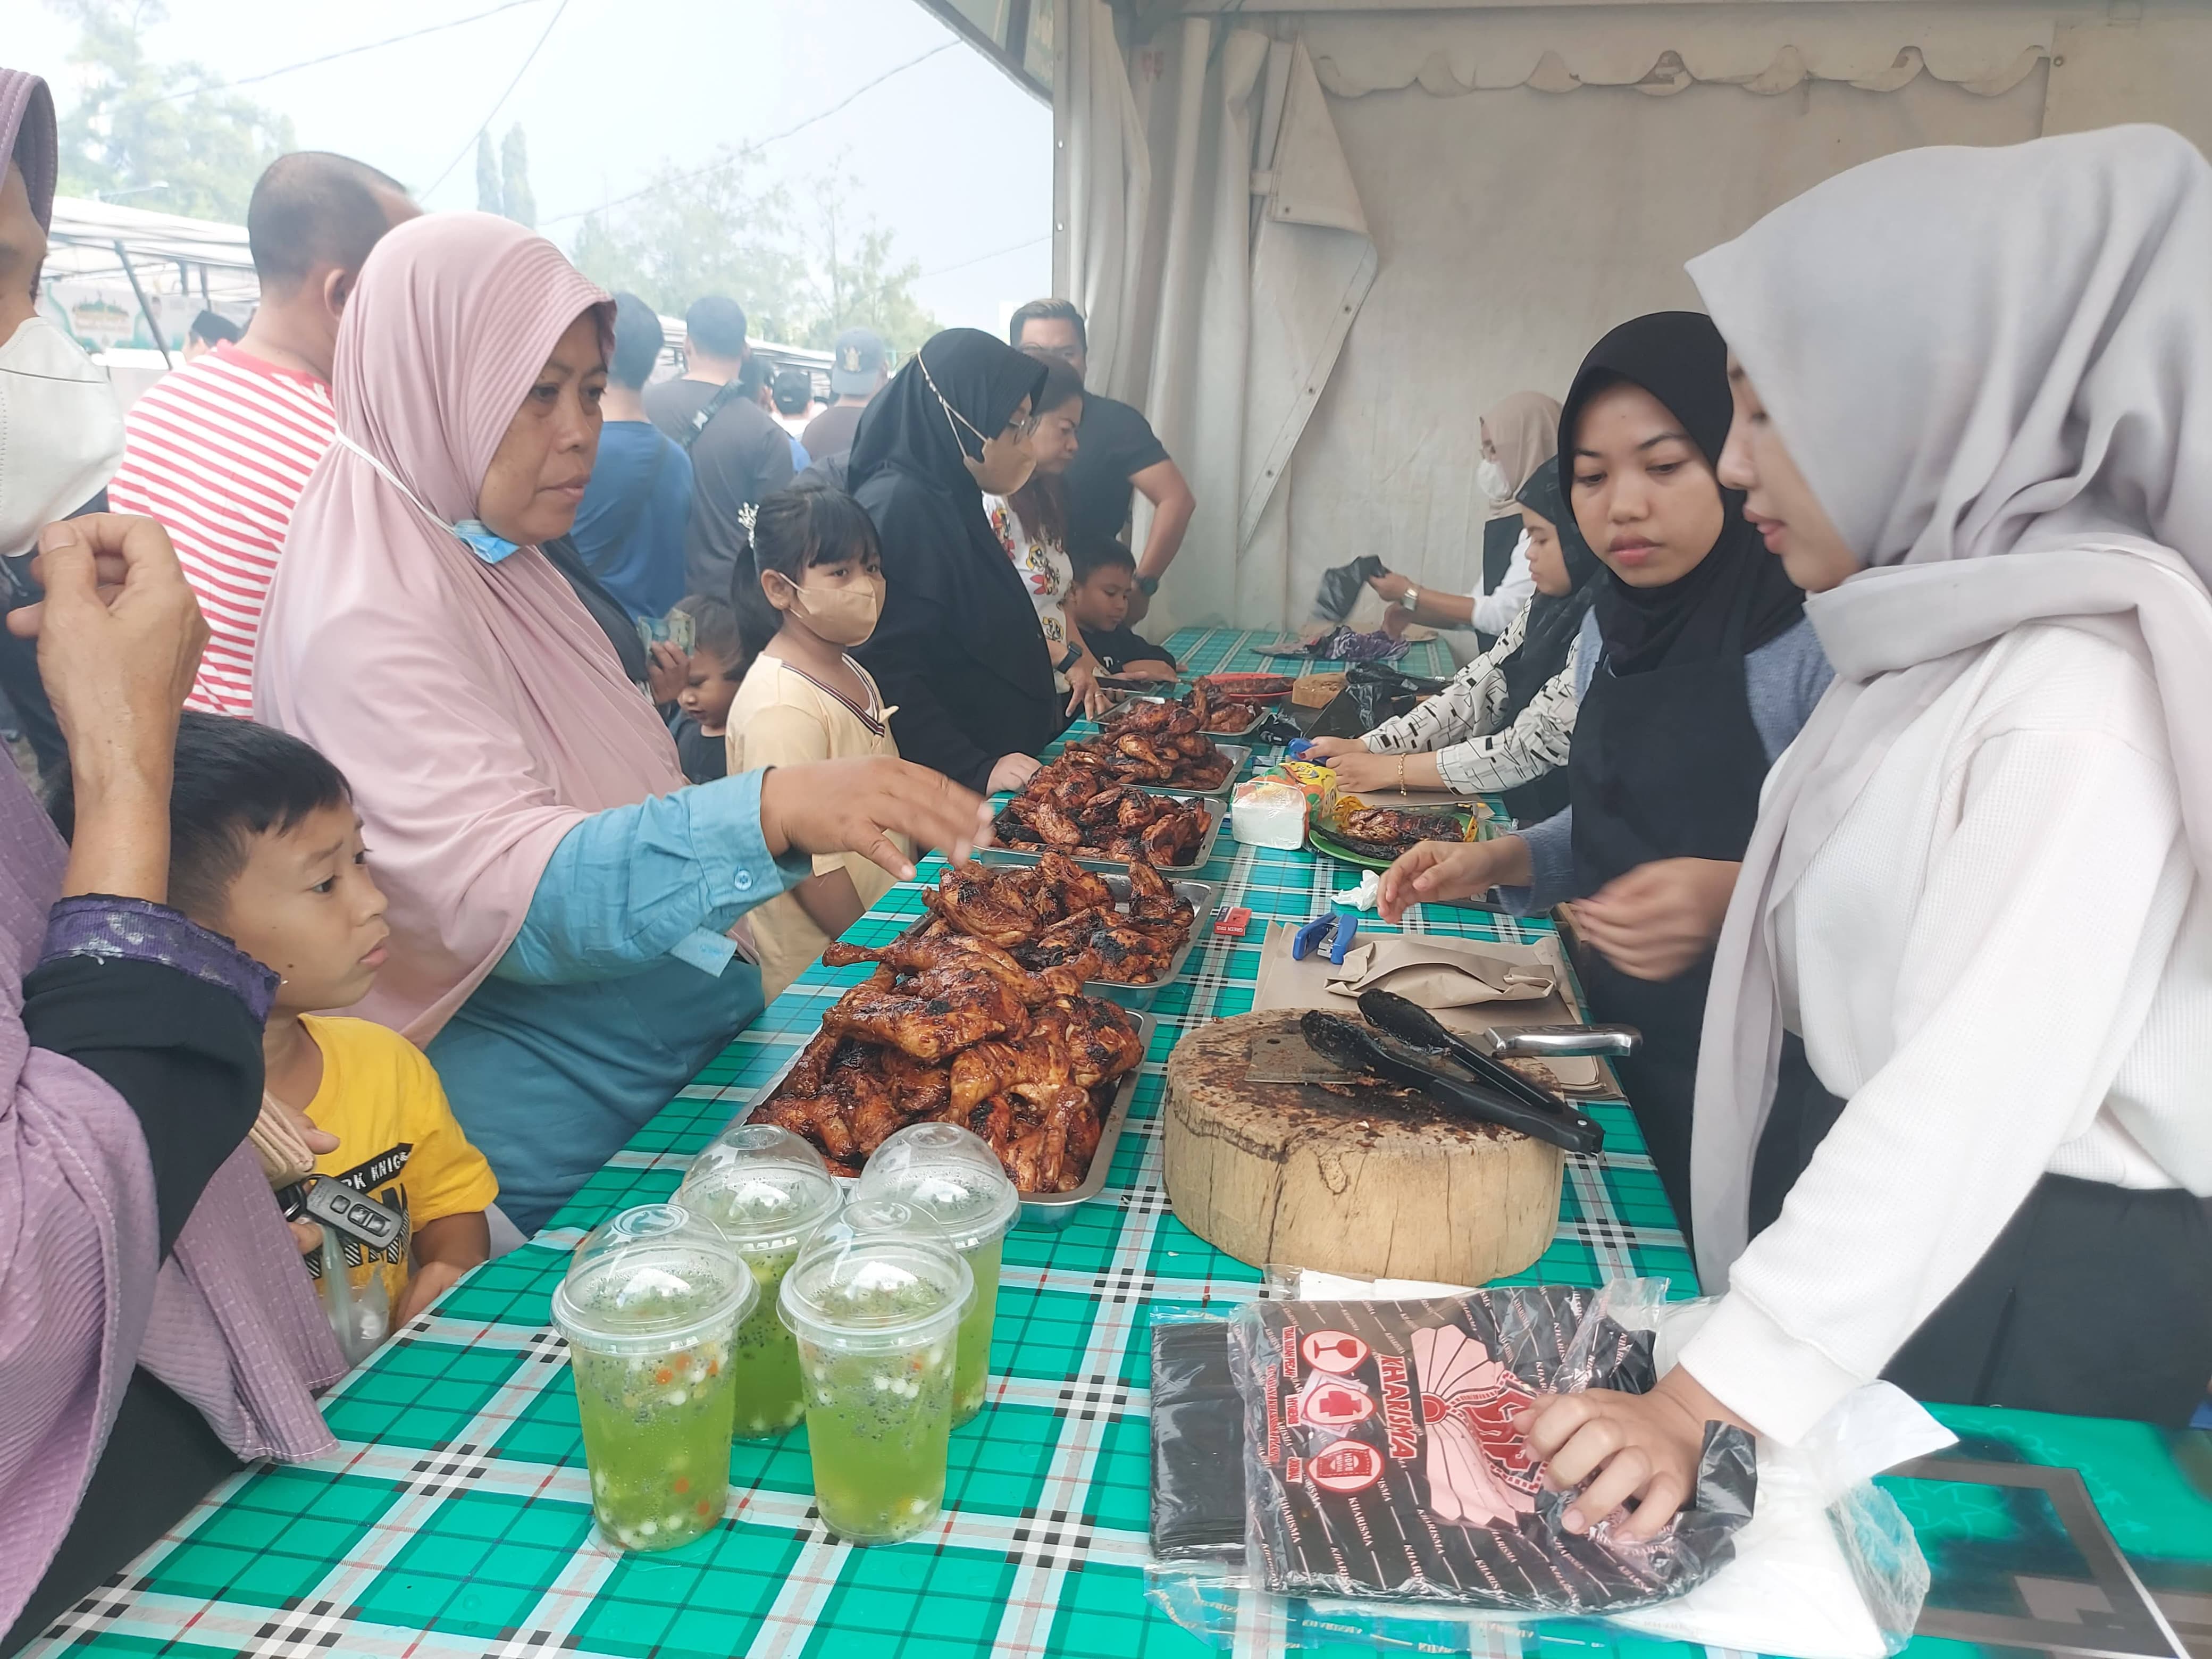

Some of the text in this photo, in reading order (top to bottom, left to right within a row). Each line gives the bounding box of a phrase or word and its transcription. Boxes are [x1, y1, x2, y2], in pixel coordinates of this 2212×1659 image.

[1284, 1358, 1297, 1376] PECAH
[1379, 1355, 1417, 1459] KHARISMA
[1344, 1453, 1353, 1471] HDPE
[1377, 1477, 1392, 1502] ISMA
[1278, 1496, 1302, 1544] KHARISMA
[1348, 1496, 1374, 1547] KHARISMA
[1417, 1508, 1445, 1555] KHARISMA
